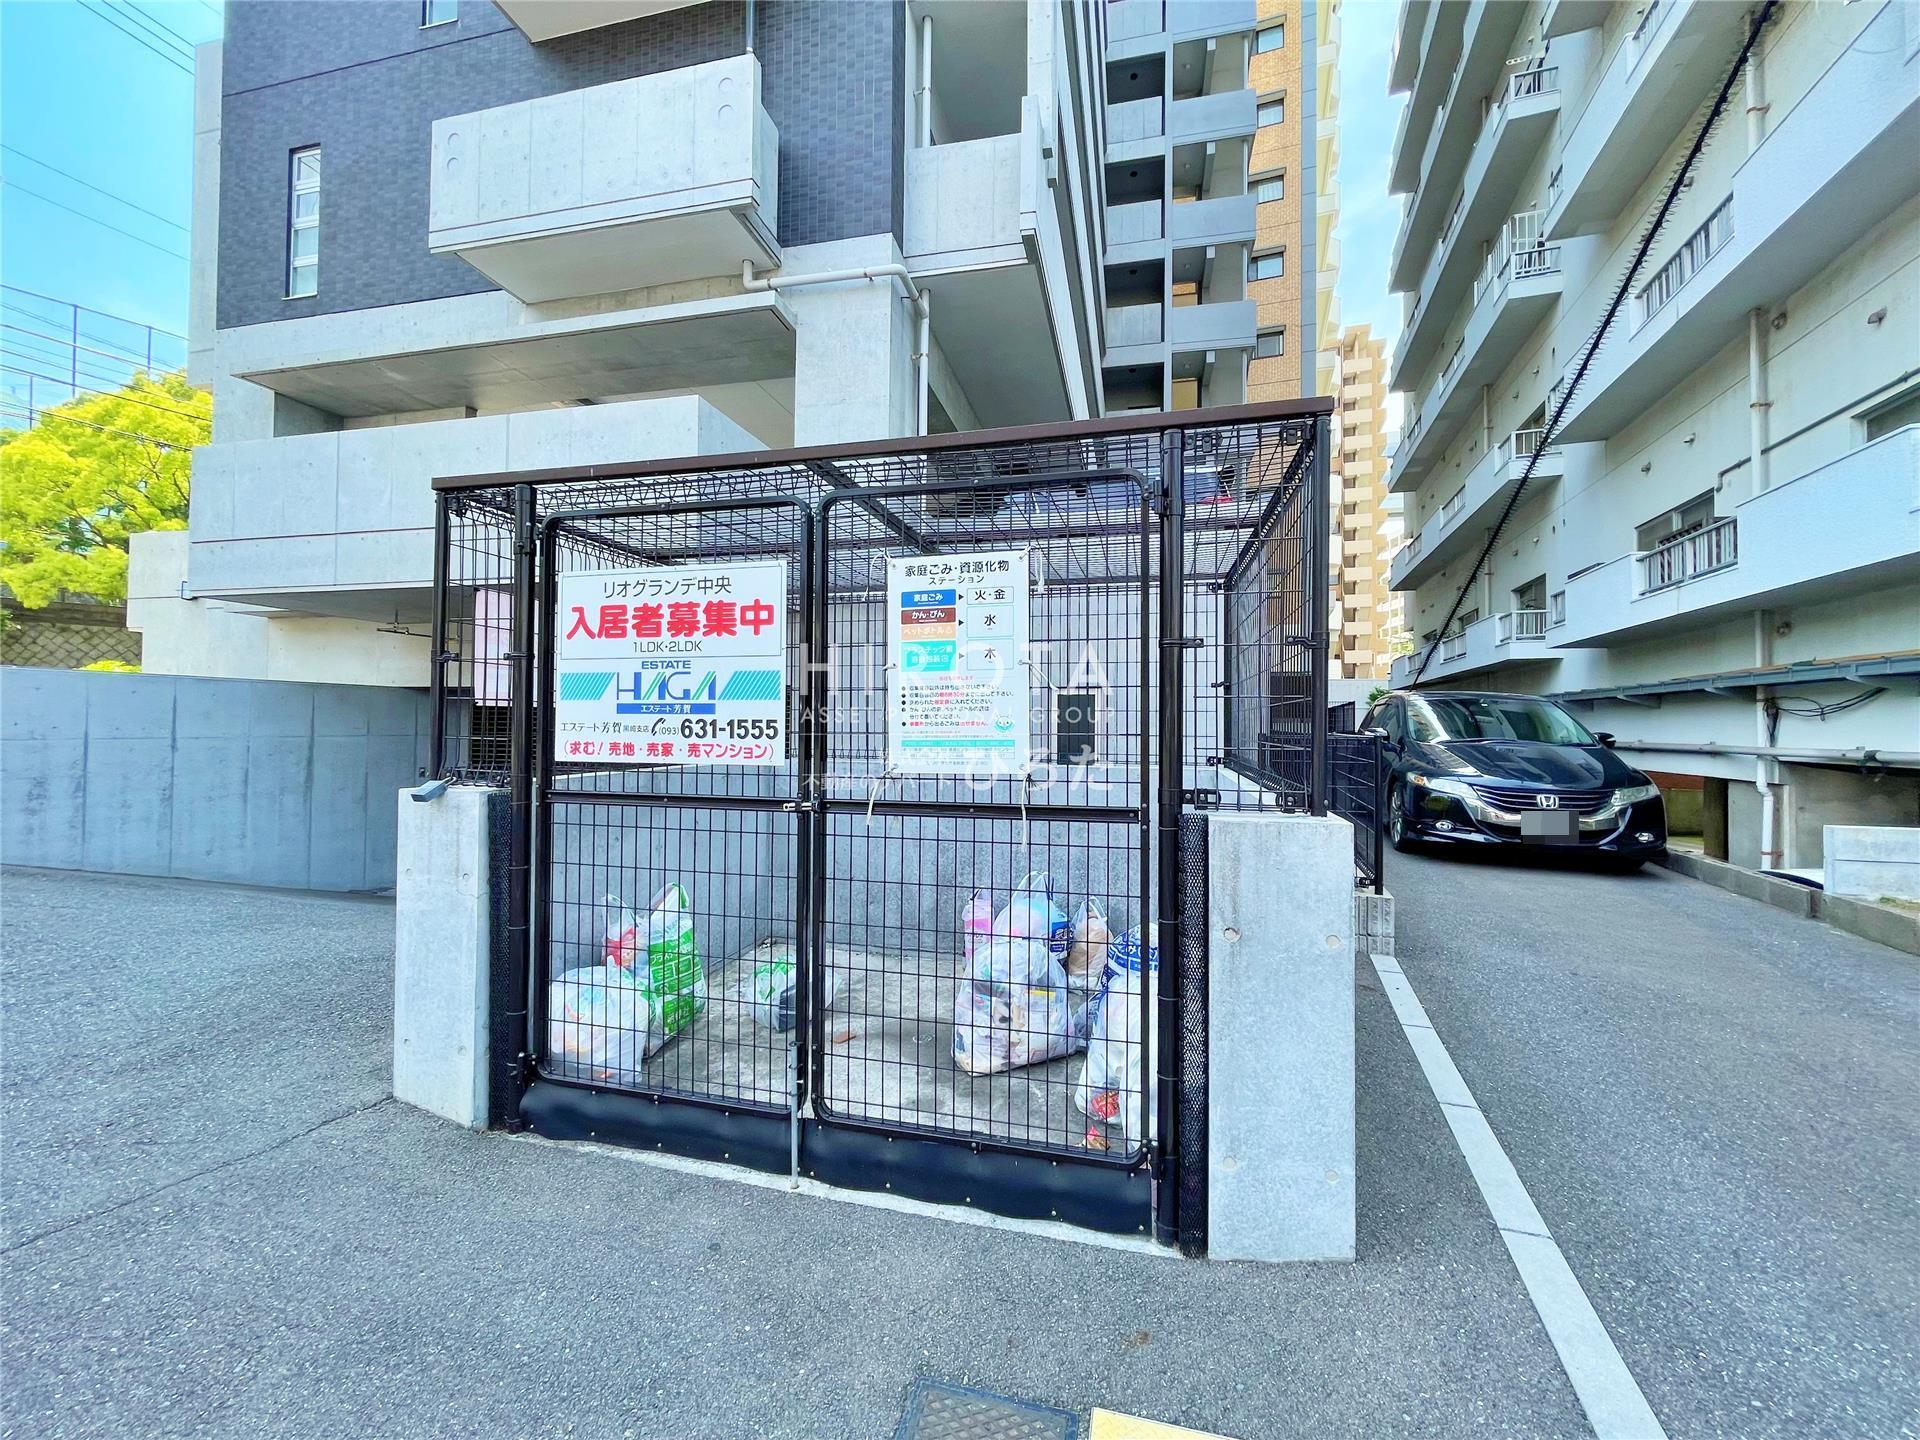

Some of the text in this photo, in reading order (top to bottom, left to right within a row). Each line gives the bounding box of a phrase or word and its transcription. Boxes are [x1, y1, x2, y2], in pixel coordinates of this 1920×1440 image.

[905, 560, 1010, 577] 家庭ごみ・資源化物
[928, 574, 985, 585] ステーション
[603, 575, 732, 599] リオグランデ中央
[913, 593, 944, 602] 家庭ごみ
[974, 588, 1006, 601] 火・金
[566, 598, 775, 640] 入居者募集中
[911, 610, 946, 619] かん・びん
[984, 614, 997, 627] 水
[984, 648, 997, 660] 木
[641, 660, 692, 669] ESTATE
[617, 671, 717, 701] HAGA
[560, 721, 622, 734] エステート芳賀
[658, 725, 680, 736] (093)
[680, 718, 779, 740] 631-1555
